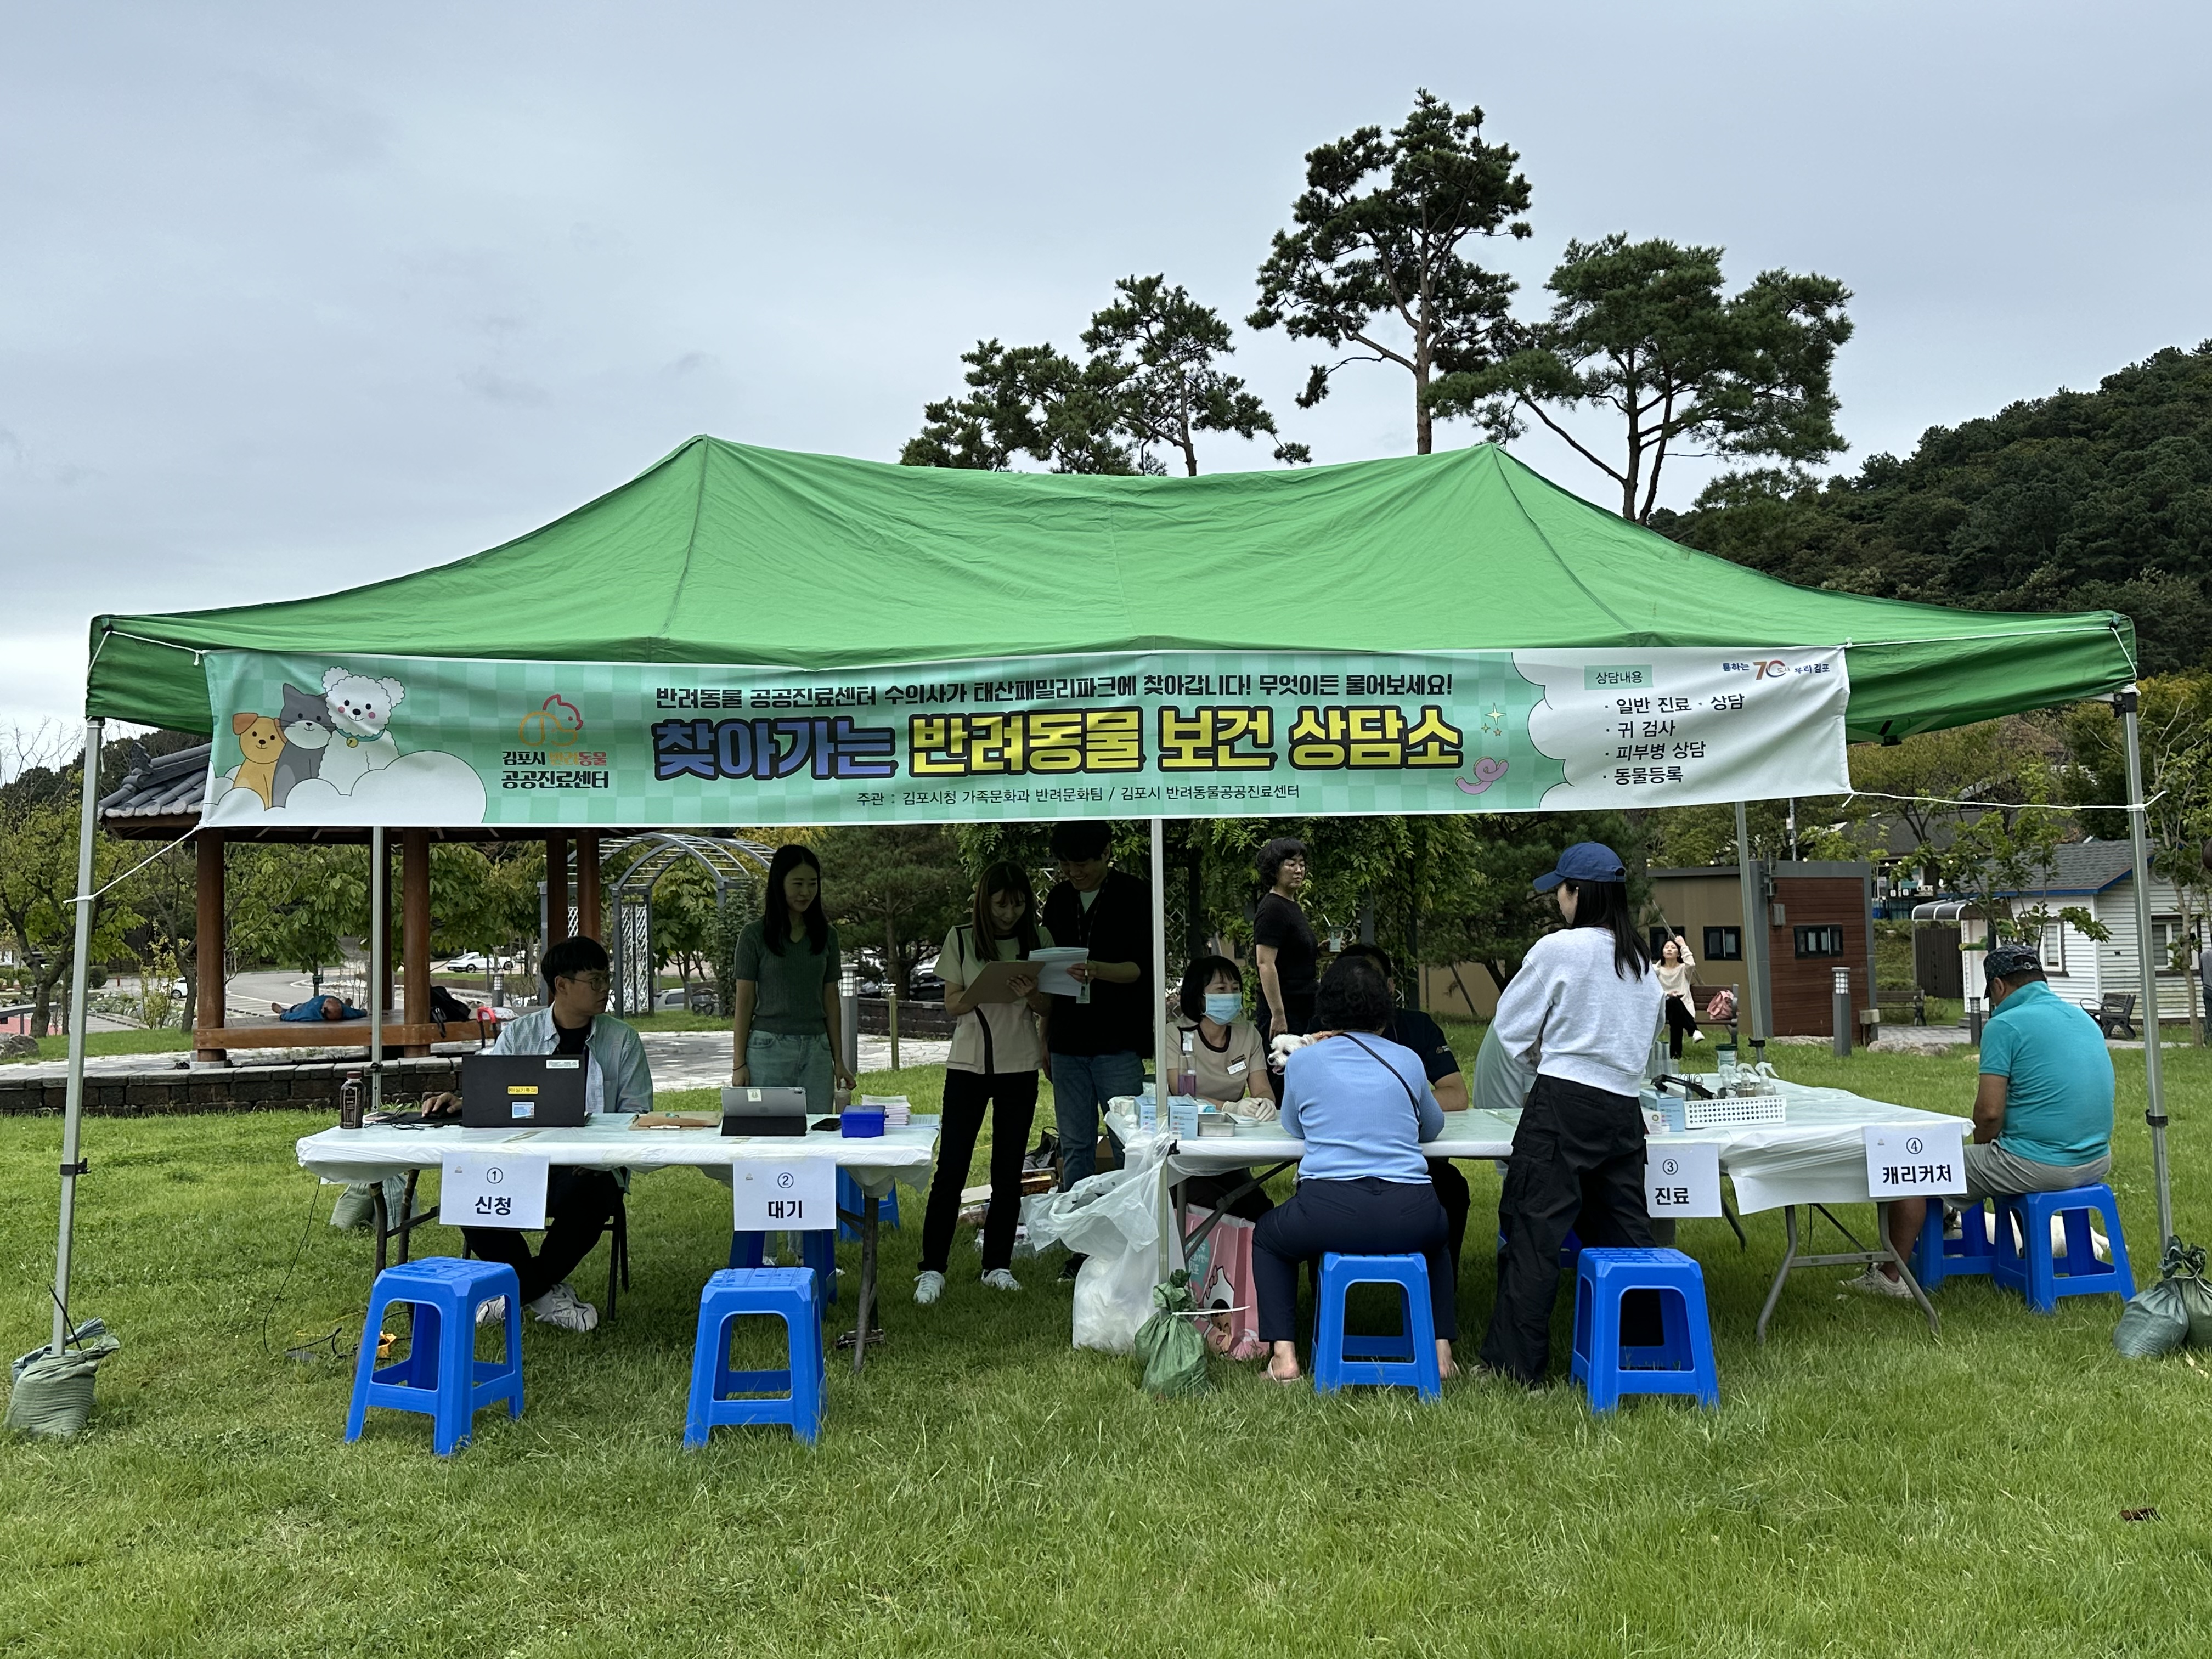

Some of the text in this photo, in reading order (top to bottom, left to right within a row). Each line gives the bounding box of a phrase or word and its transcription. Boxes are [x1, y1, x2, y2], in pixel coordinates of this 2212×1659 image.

[1814, 664, 1830, 673] 김포
[1596, 672, 1642, 684] 상담내용
[657, 674, 1452, 708] 반려동물 공공진료센터 수의사가 태산패밀리파크에 찾아갑니다! 무엇이든 물어보세요!
[1617, 694, 1745, 714] 일반 진료 상담
[1618, 720, 1675, 738] 귀 검사
[651, 705, 1464, 781] 찾아가는 반려동물 보건 상담소
[1616, 741, 1706, 761] 피부병 상담
[502, 752, 545, 765] 김포시
[501, 771, 608, 789] 공공진료센터
[1615, 766, 1683, 785] 동물등록
[857, 793, 884, 805] 주관
[903, 791, 956, 805] 김포시청
[963, 789, 1030, 803] 가족문화과
[1036, 788, 1102, 802] 반려문화팀
[1121, 786, 1160, 800] 김포시
[1167, 785, 1299, 799] 반려동물공공진료센터
[1883, 1165, 1951, 1184] 캐리커처
[1655, 1188, 1689, 1205] 진료
[475, 1197, 511, 1215] 신청
[768, 1201, 802, 1218] 대기
